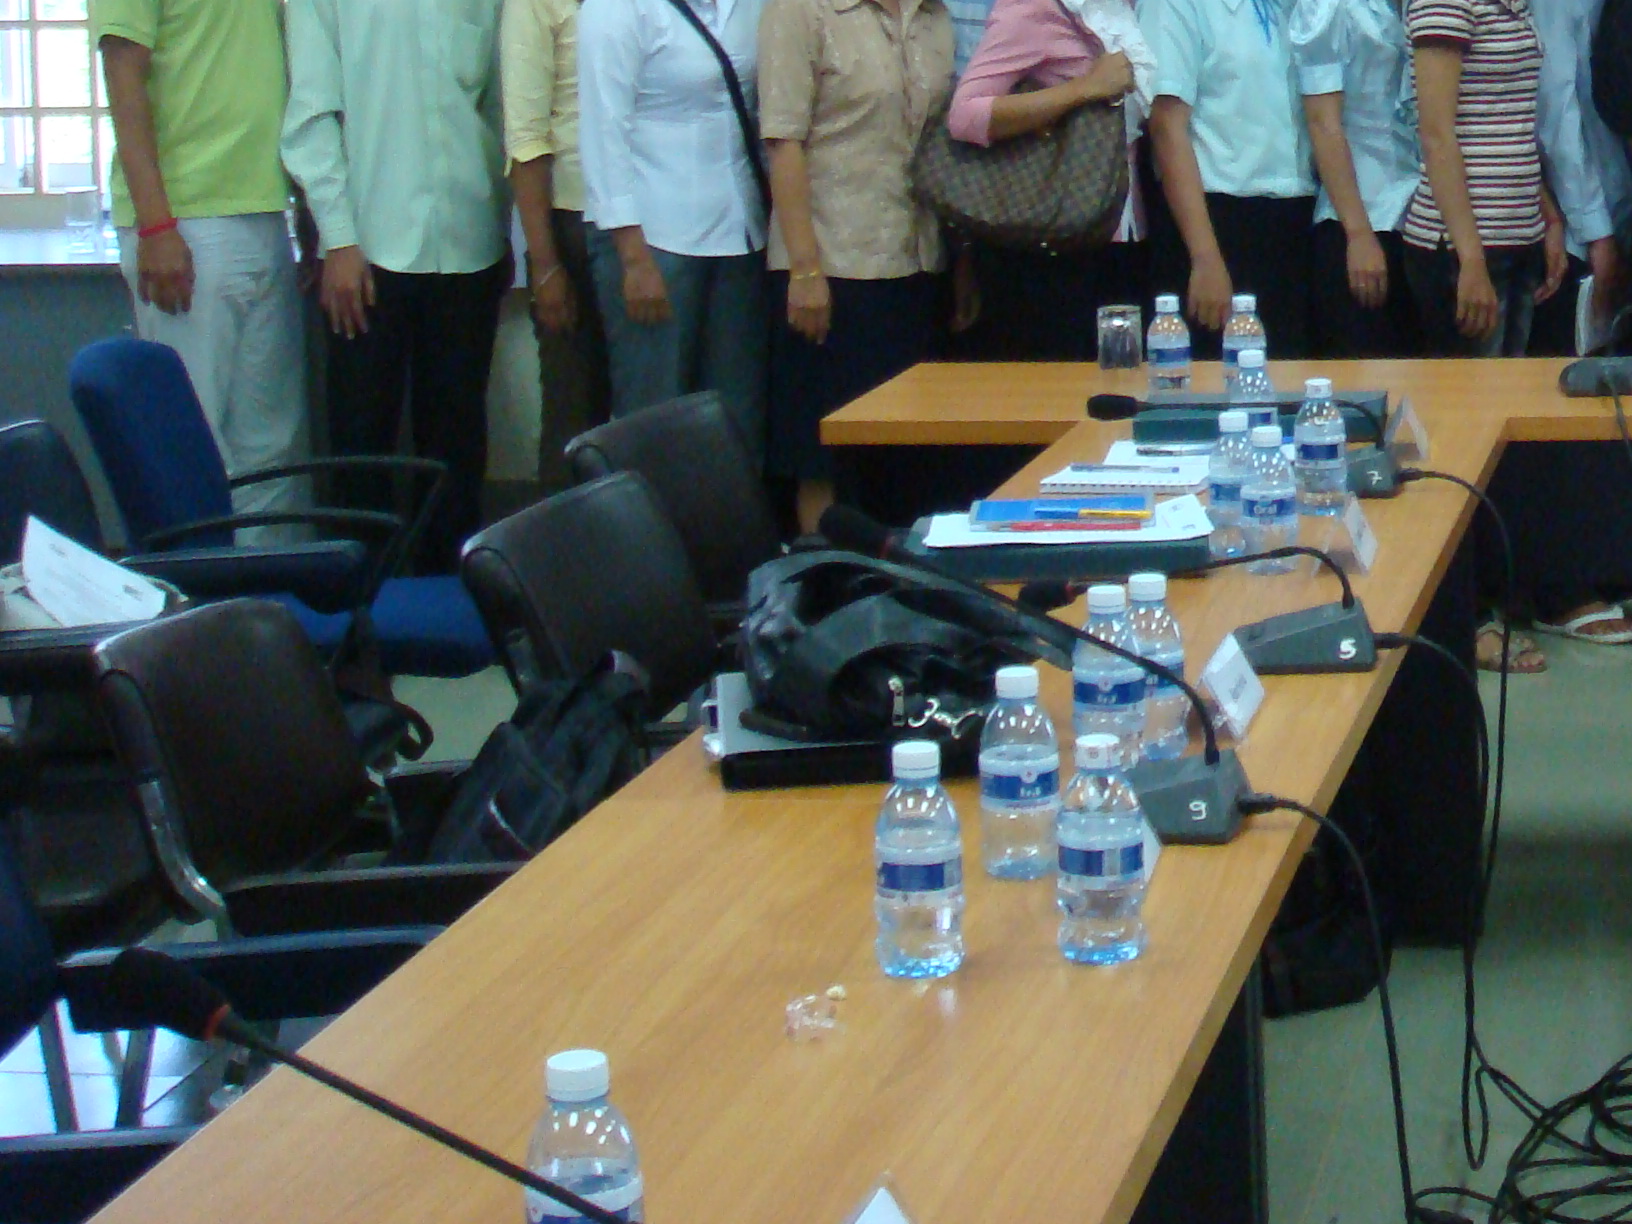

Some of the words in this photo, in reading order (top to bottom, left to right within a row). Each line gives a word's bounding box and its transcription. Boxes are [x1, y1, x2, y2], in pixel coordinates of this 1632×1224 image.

[1366, 470, 1383, 486] 7
[1339, 637, 1358, 660] 5
[1188, 800, 1207, 821] 9
